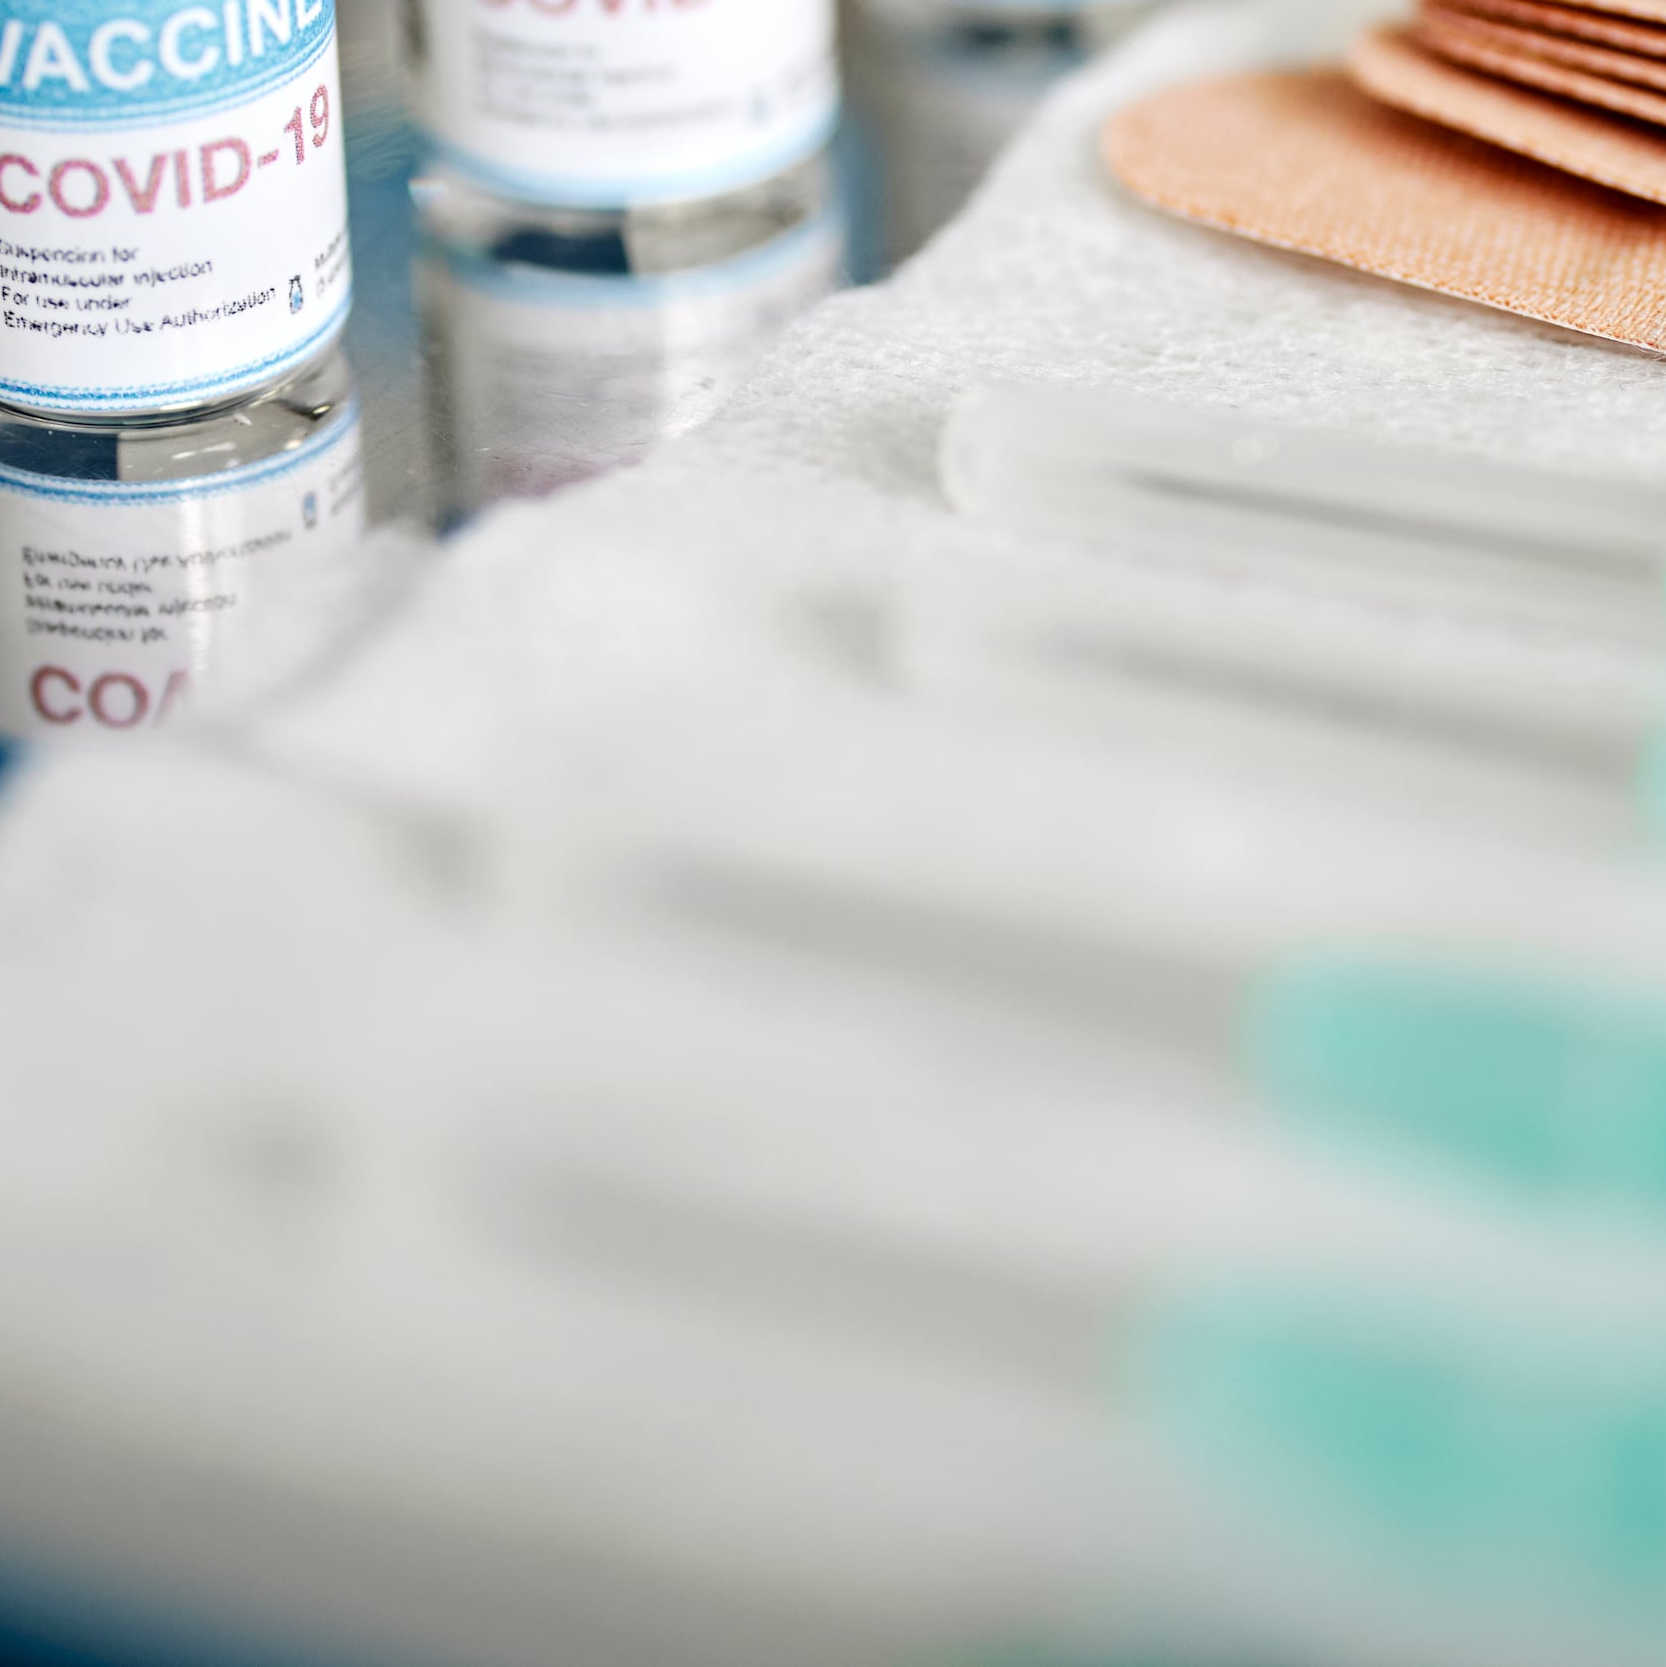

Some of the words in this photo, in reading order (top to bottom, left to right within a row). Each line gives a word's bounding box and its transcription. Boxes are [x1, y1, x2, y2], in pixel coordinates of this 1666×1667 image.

[2, 285, 29, 306] For
[76, 294, 131, 311] under
[3, 310, 108, 338] Emergency
[114, 317, 154, 334] Use
[159, 287, 276, 329] Authorization
